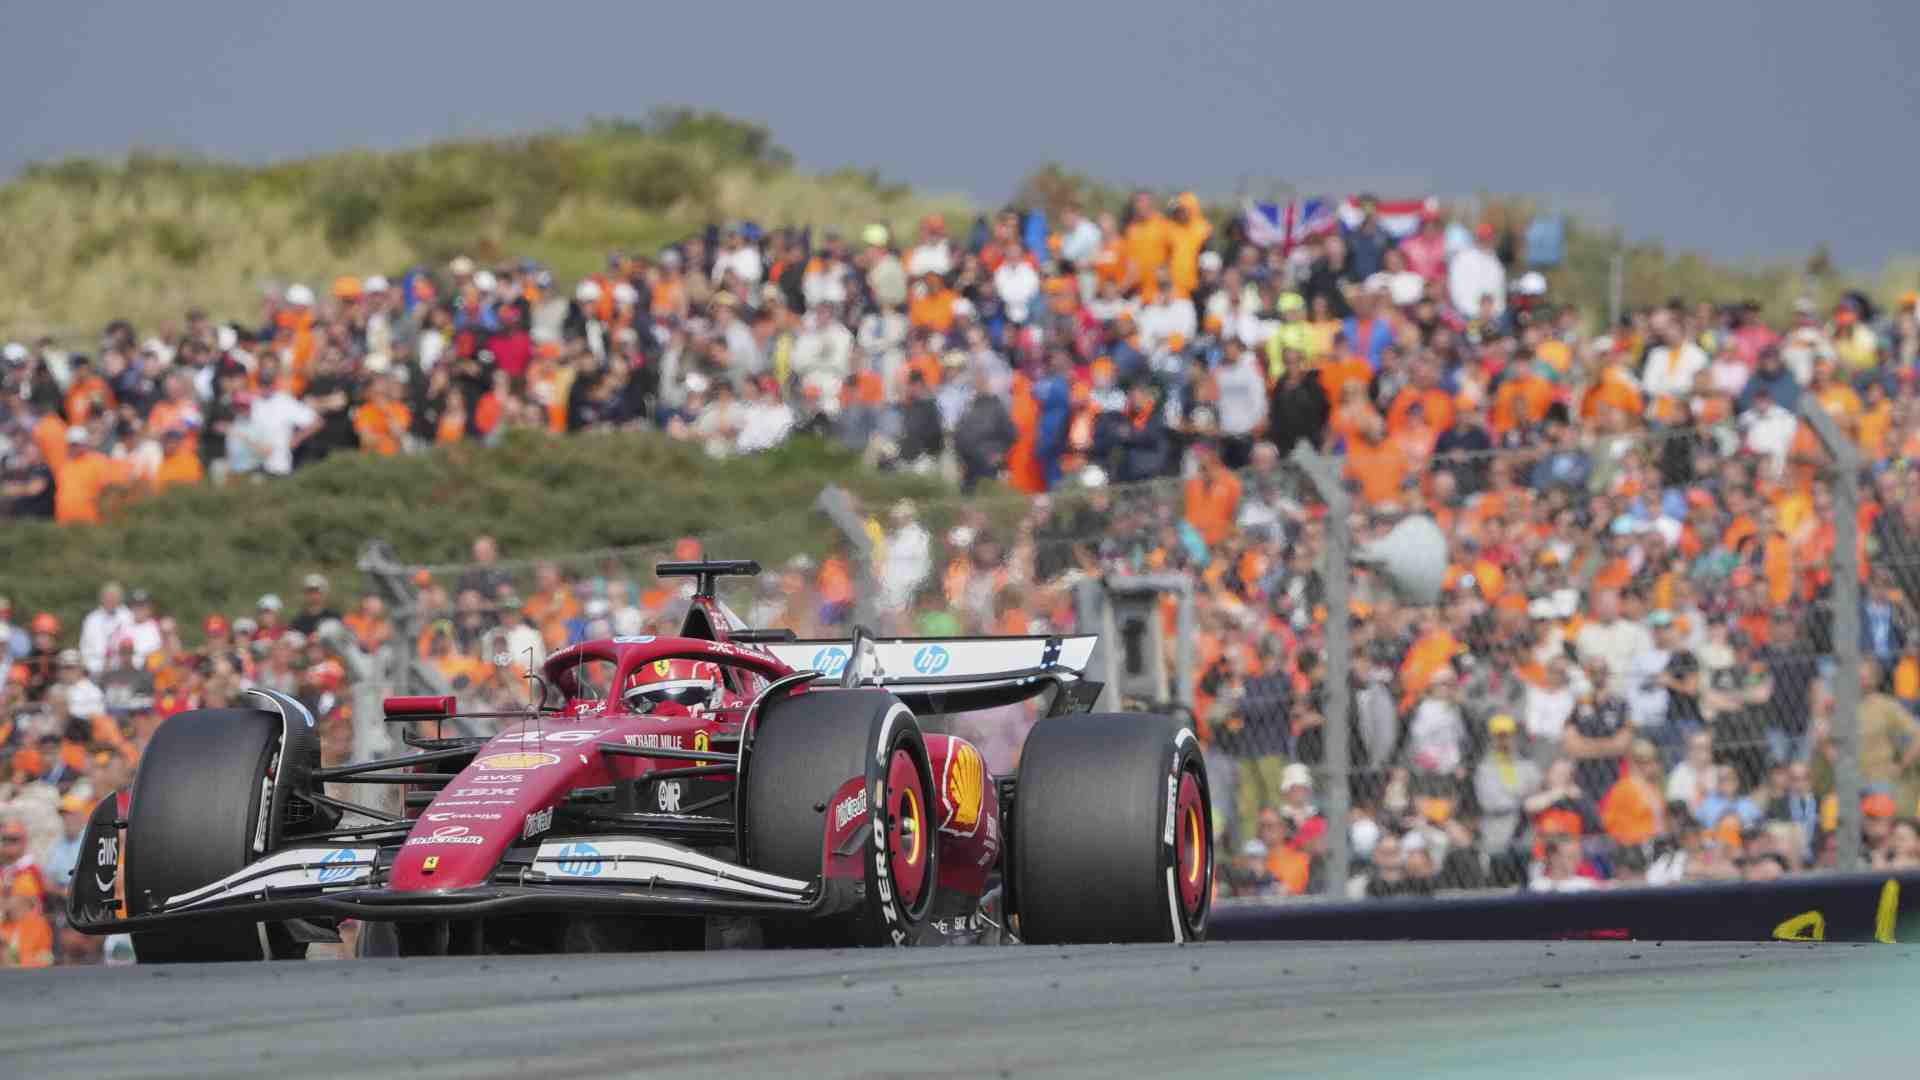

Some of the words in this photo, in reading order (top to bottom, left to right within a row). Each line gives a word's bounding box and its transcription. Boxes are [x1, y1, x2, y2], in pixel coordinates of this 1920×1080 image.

[818, 649, 847, 676] hp
[919, 646, 948, 673] hp
[452, 787, 520, 796] IBM
[474, 774, 524, 782] aws
[97, 836, 118, 866] aws
[564, 844, 598, 875] hp
[873, 816, 898, 924] ZERO
